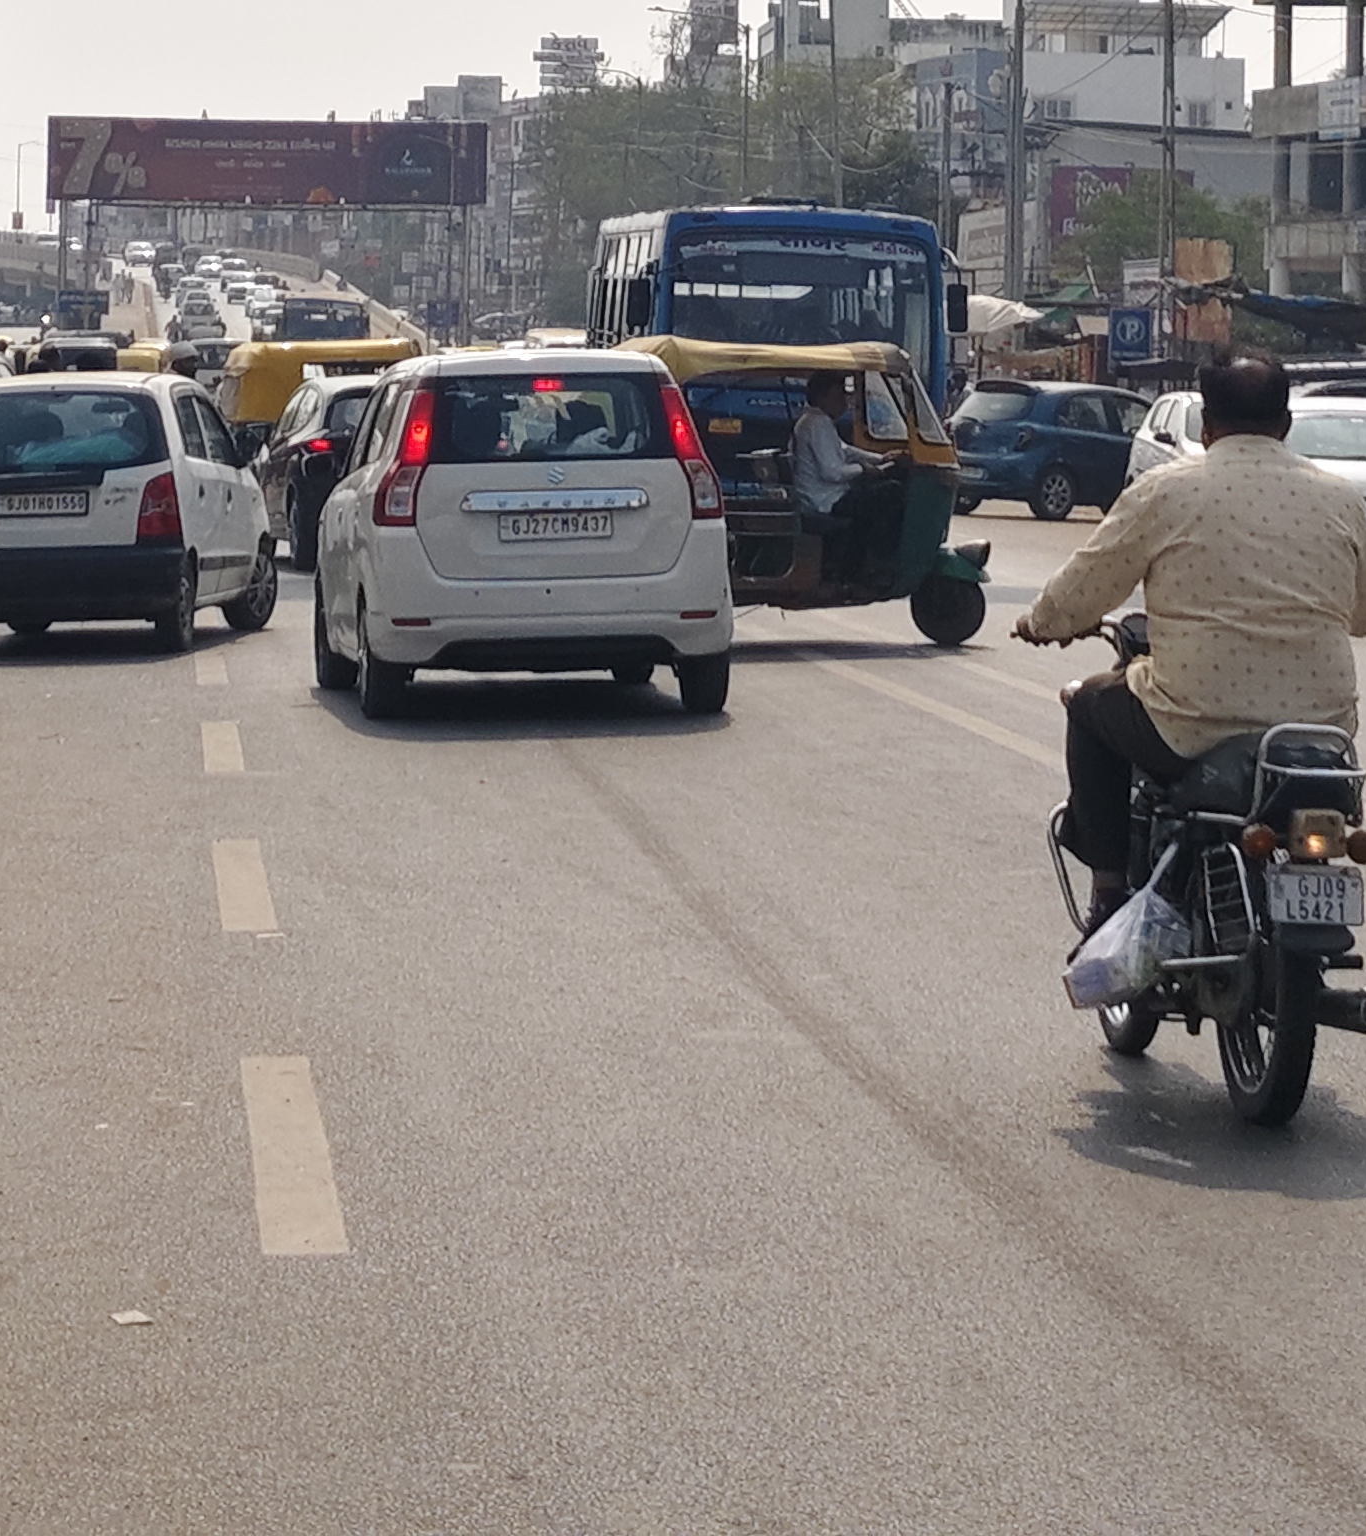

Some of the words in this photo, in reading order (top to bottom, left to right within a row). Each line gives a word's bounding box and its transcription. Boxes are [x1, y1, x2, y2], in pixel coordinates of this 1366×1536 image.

[511, 514, 609, 536] GJ27CM9437
[1298, 875, 1347, 898] GJ09
[1286, 900, 1346, 923] L5421
